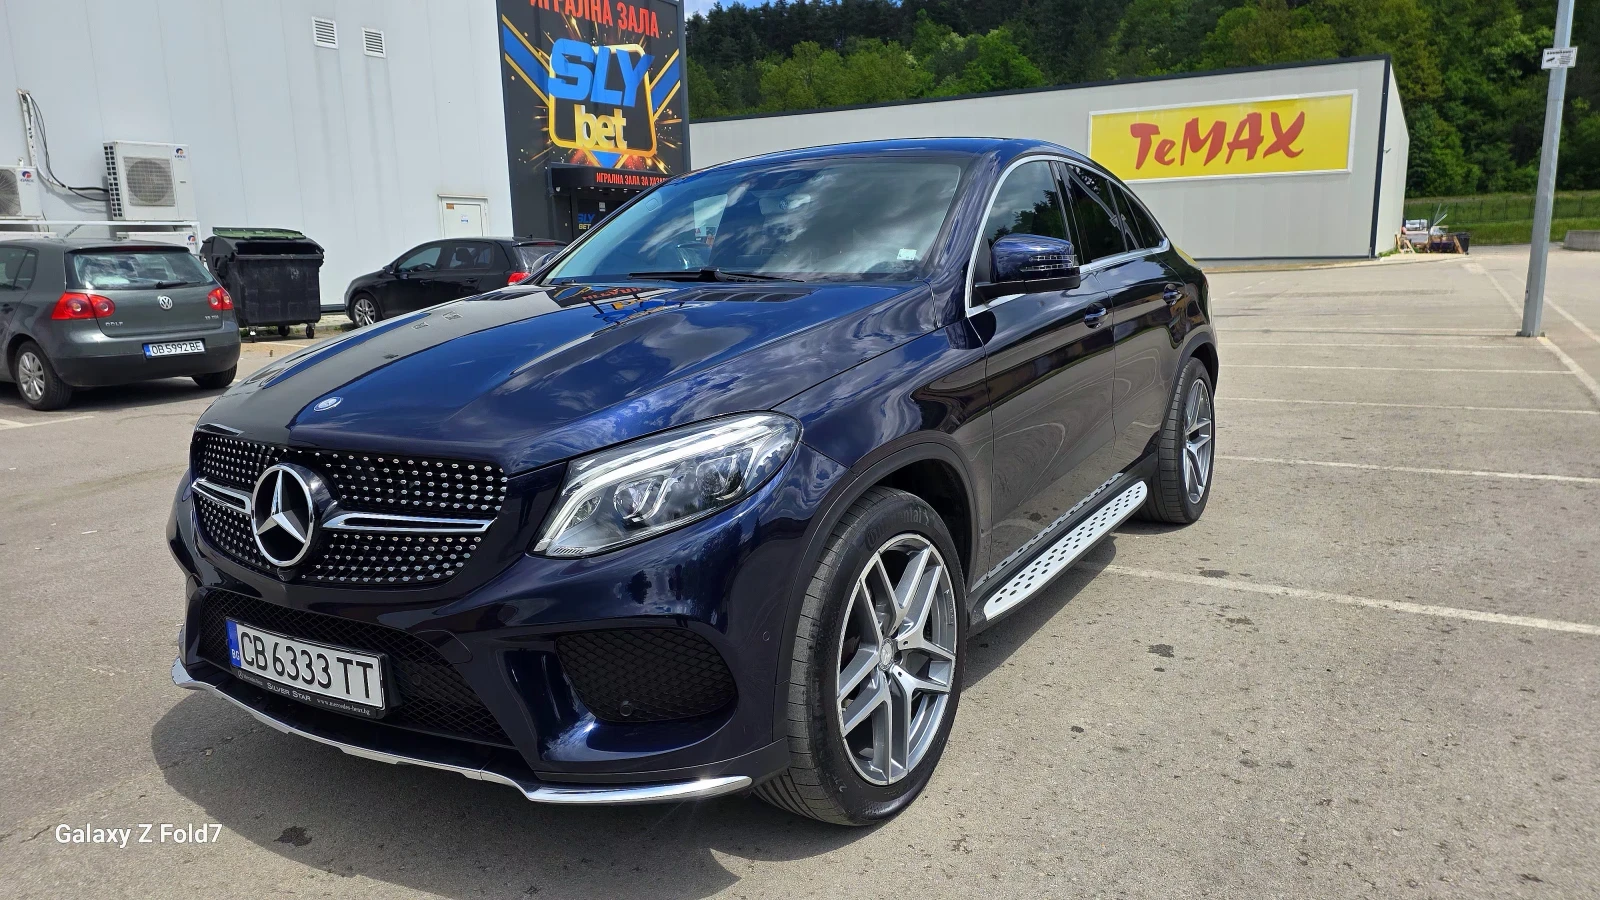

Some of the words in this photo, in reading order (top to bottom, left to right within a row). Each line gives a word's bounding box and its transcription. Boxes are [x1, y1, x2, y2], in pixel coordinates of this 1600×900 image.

[616, 2, 660, 38] ЗАЛА
[548, 38, 655, 107] SLY
[574, 104, 628, 149] bet
[596, 172, 624, 185] ИГРАЛНА
[624, 174, 640, 186] ЗАЛА
[641, 176, 649, 186] ЗА
[165, 342, 189, 354] 5992
[240, 631, 268, 672] CB
[272, 641, 332, 690] 6333
[336, 656, 373, 699] TT
